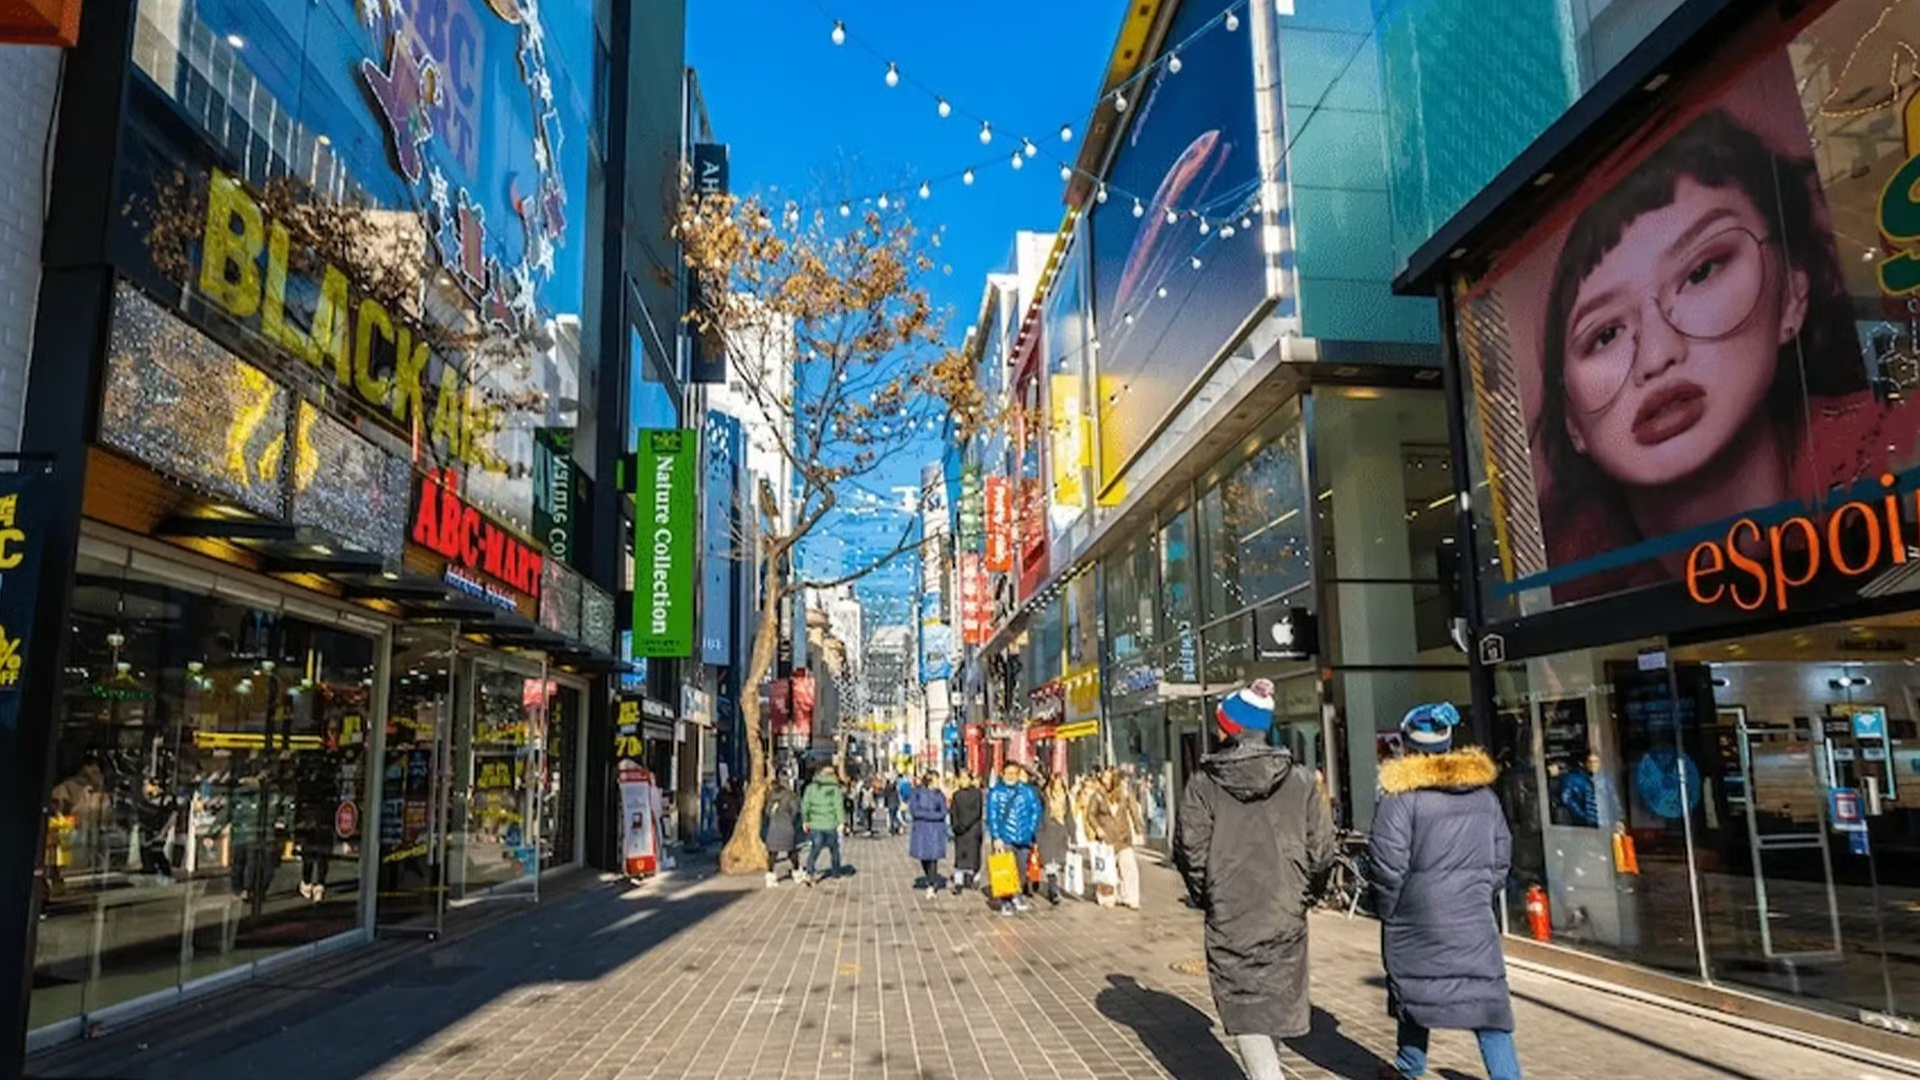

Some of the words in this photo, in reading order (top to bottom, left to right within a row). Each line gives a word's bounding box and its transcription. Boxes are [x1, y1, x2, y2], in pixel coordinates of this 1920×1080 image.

[702, 160, 719, 193] AH
[199, 167, 430, 442] BLACK
[413, 478, 543, 598] ABC-MART
[654, 456, 674, 523] Nature
[1686, 473, 1920, 611] espoi
[652, 528, 673, 634] Collection
